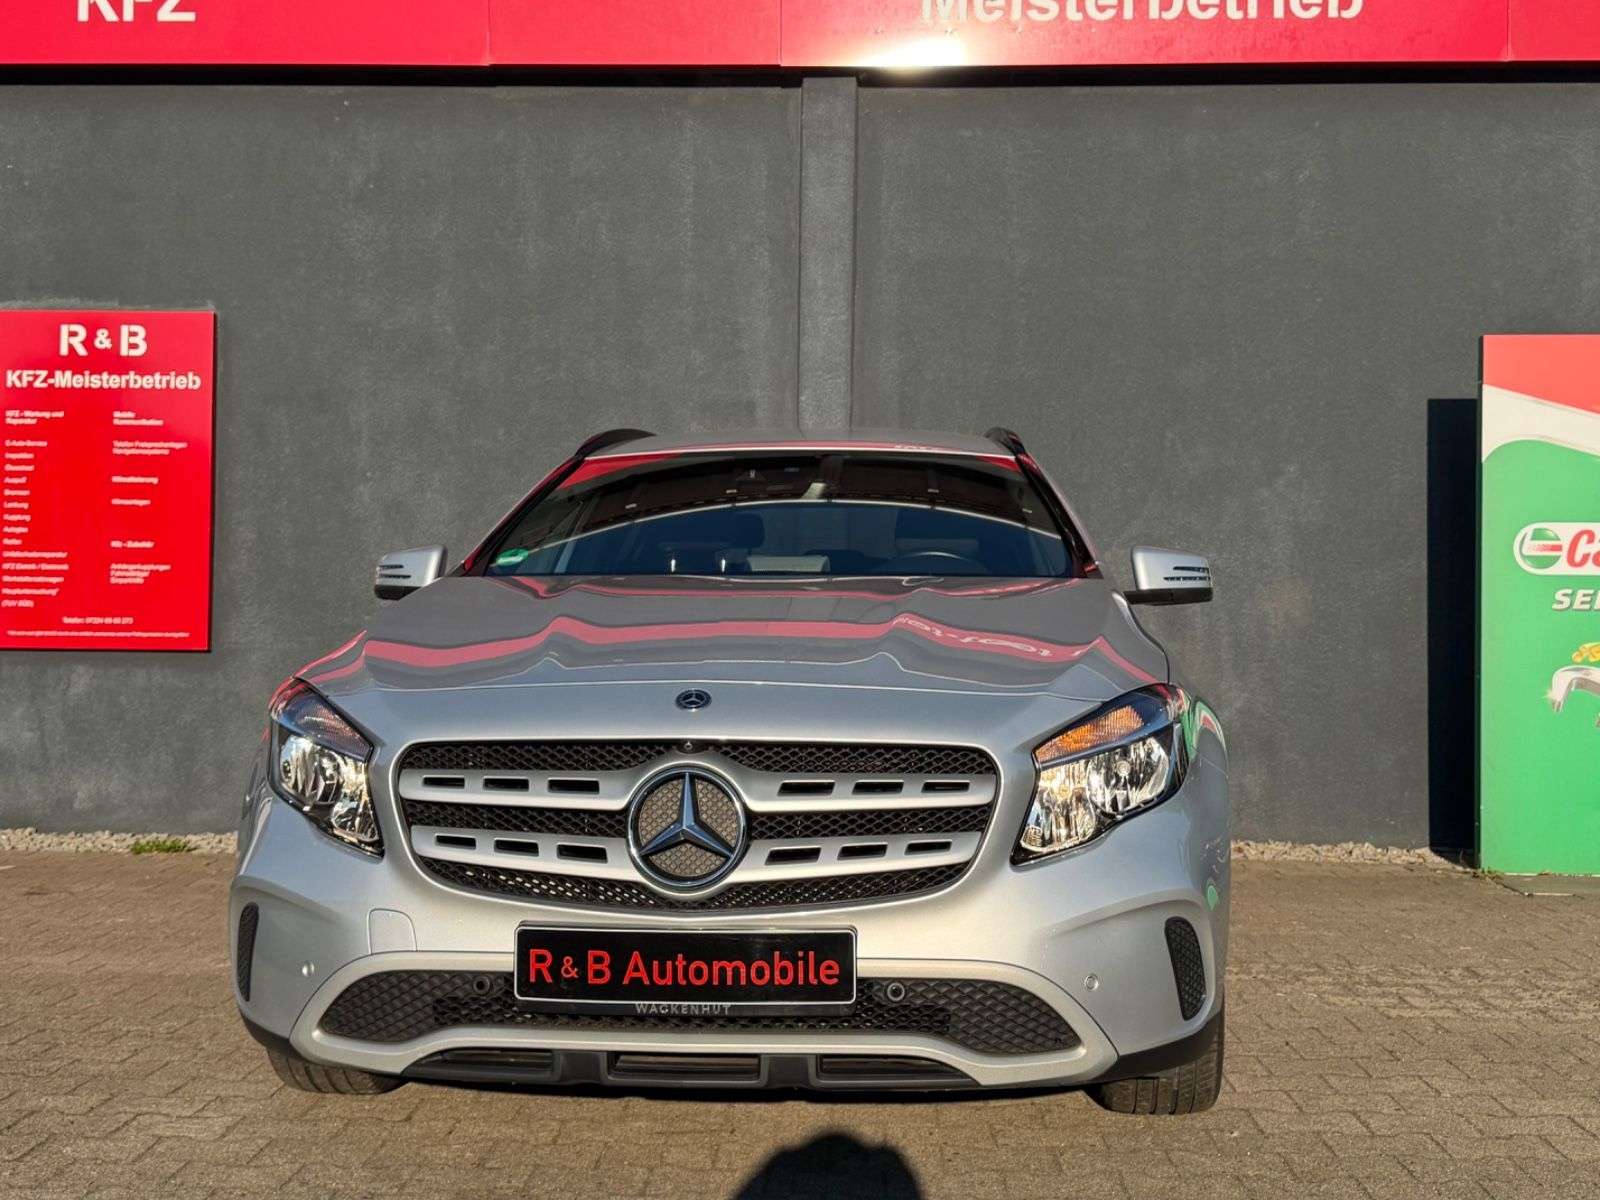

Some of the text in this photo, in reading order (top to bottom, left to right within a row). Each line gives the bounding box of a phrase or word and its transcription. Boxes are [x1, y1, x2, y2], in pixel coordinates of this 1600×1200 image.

[59, 324, 148, 357] R & B
[6, 369, 202, 390] KFZ-Meisterbetrieb
[1552, 588, 1600, 611] SE
[529, 949, 840, 986] R & B Automobile
